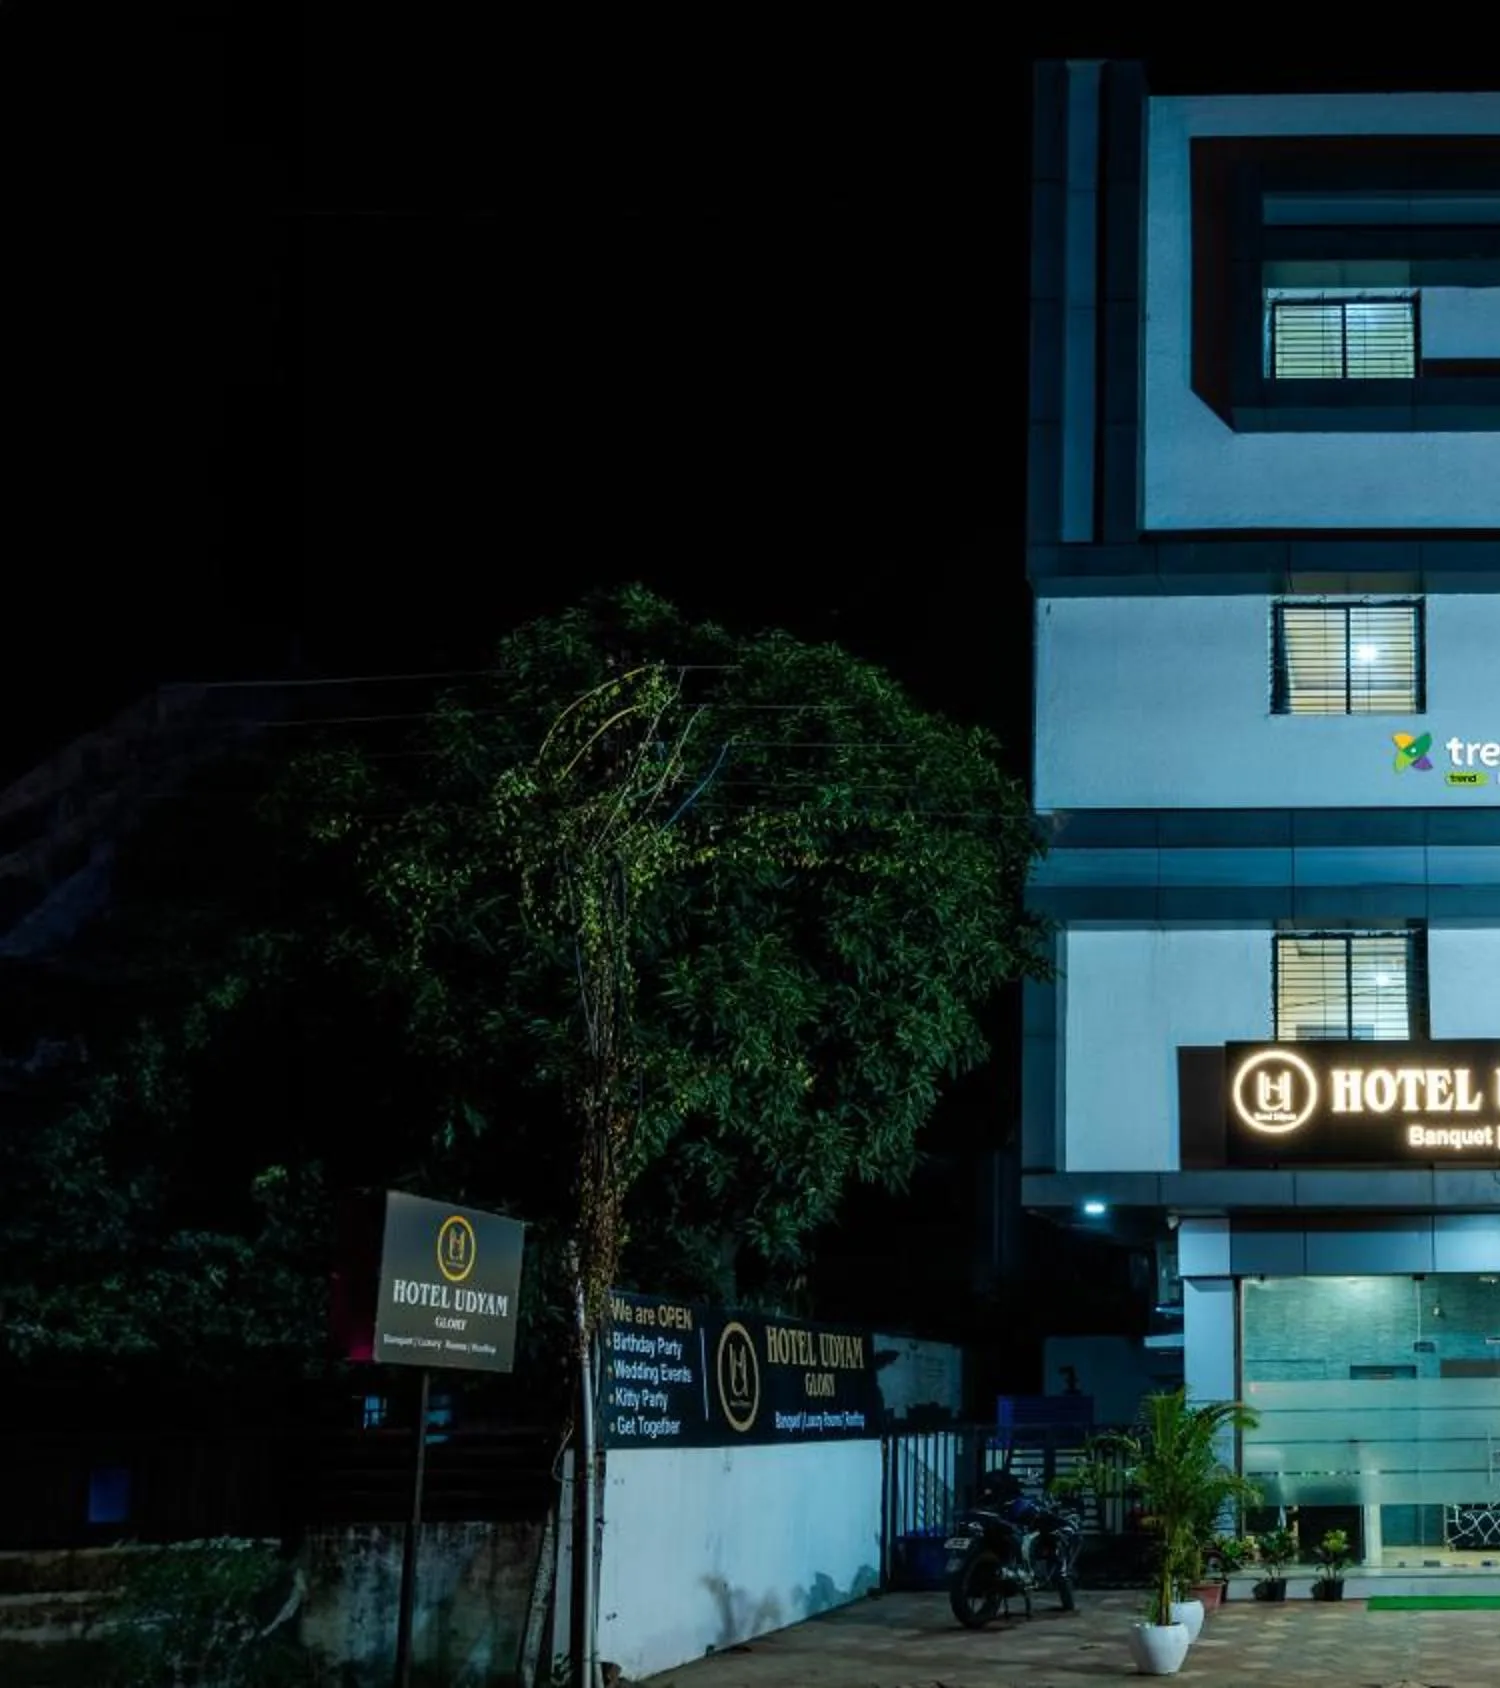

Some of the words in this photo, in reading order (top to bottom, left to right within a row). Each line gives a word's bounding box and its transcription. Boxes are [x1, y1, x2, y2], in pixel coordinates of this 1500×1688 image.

[1331, 1068, 1482, 1113] HOTEL
[1408, 1123, 1493, 1150] Banquet
[393, 1279, 450, 1309] HOTEL
[454, 1289, 510, 1317] UDYAM
[609, 1297, 633, 1322] We
[635, 1305, 656, 1326] are
[658, 1304, 694, 1331] OPEN
[613, 1331, 656, 1359] Birthday
[657, 1336, 684, 1361] Party
[766, 1325, 817, 1367] HOTEL
[819, 1333, 865, 1369] UDYAM
[613, 1360, 660, 1386] Wedding
[660, 1364, 693, 1384] Events
[615, 1387, 640, 1414] Kitty
[641, 1389, 669, 1413] Party
[617, 1416, 636, 1436] Get
[637, 1415, 681, 1439] Together
